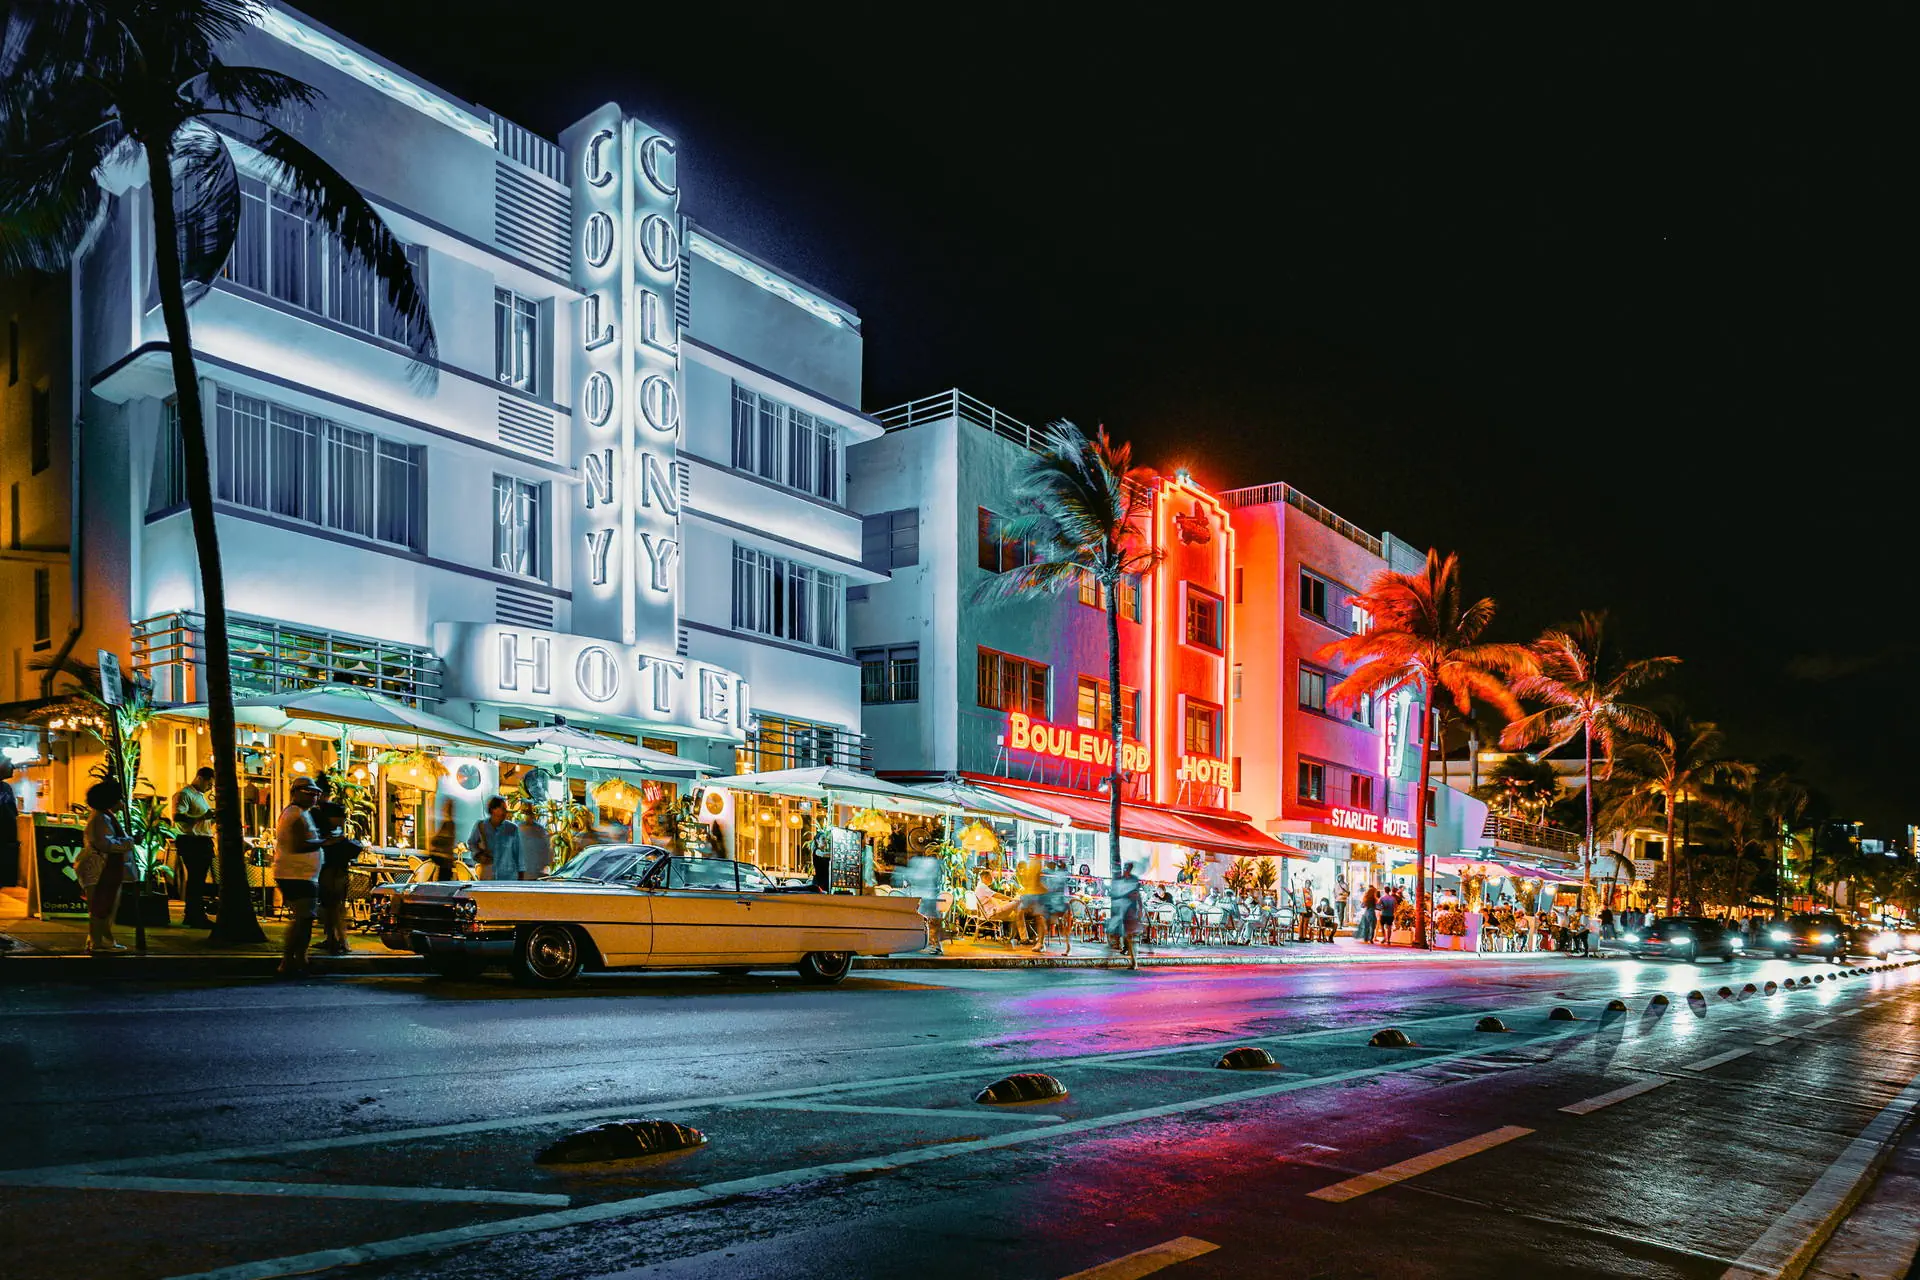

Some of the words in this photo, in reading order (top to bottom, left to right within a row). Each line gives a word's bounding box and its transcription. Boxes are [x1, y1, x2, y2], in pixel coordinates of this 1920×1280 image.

[584, 129, 615, 585] COLONY
[640, 135, 679, 592] COLONY
[498, 631, 757, 730] HOTEL
[45, 845, 82, 863] CV
[1331, 807, 1379, 833] STARLITE
[1382, 816, 1412, 838] HOTEL
